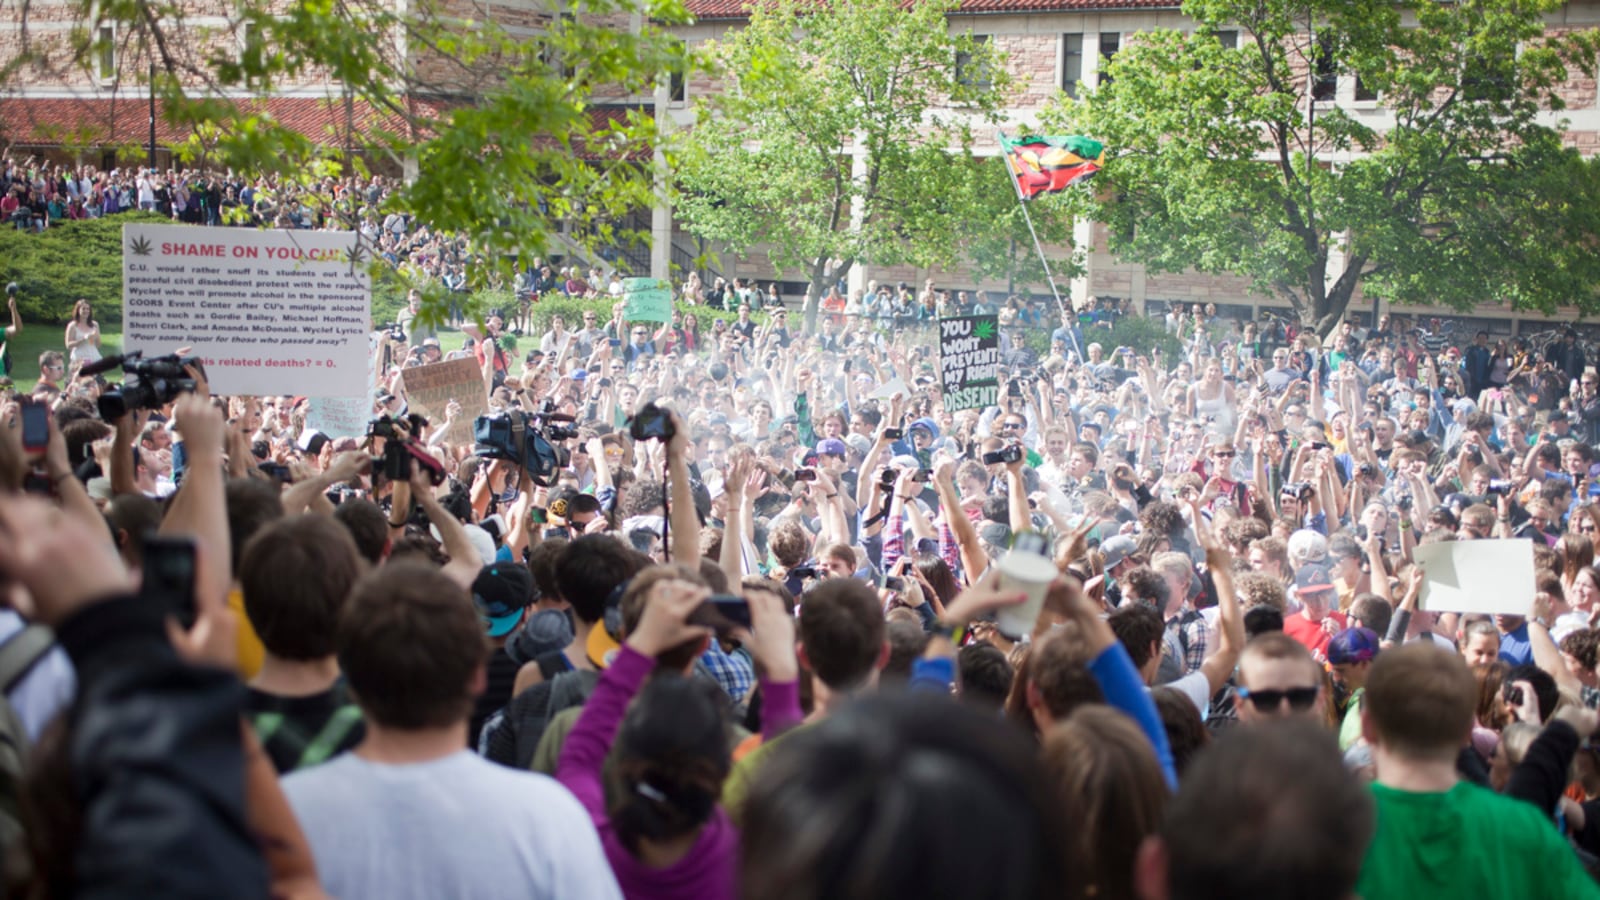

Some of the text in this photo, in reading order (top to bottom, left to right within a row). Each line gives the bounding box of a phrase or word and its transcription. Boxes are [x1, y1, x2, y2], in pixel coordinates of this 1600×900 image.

[162, 242, 226, 257] SHAME
[232, 246, 258, 258] ON
[265, 246, 302, 260] YOU
[198, 278, 252, 287] disobedient
[256, 281, 289, 289] protest
[129, 287, 161, 296] Wyclef
[289, 304, 326, 312] multiple
[246, 314, 278, 322] Bailey,
[323, 316, 364, 324] Hoffman,
[161, 322, 188, 331] Clark,
[252, 325, 299, 333] McDonald.
[303, 326, 333, 334] Wyclef
[941, 320, 971, 337] YOU
[219, 358, 261, 366] related
[265, 359, 312, 367] deaths?
[326, 360, 336, 368] 0.
[942, 348, 997, 372] PREVENT
[944, 364, 997, 384] MY RIGHT
[948, 384, 959, 393] to
[944, 385, 998, 413] DISSENT
